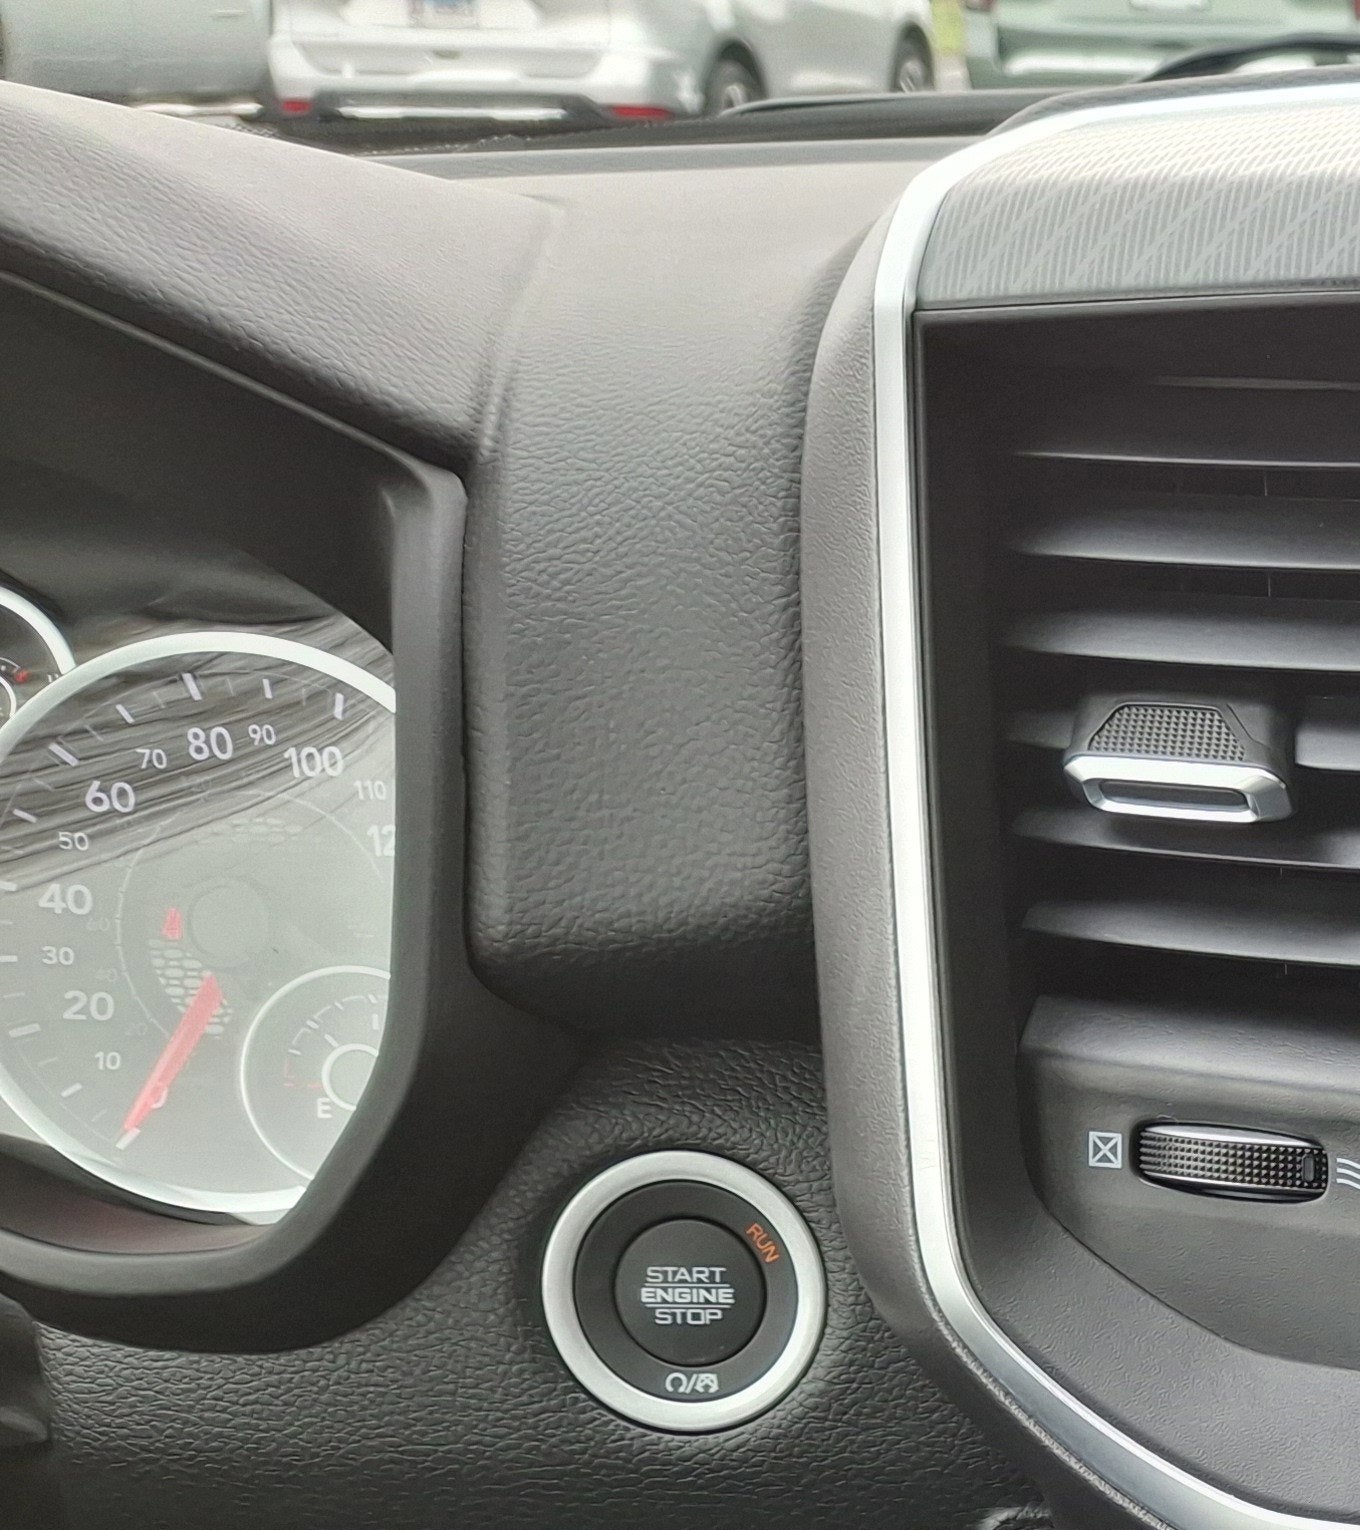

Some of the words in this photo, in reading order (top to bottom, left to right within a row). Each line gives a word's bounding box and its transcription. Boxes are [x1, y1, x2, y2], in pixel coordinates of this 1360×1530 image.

[187, 726, 233, 761] 80
[248, 724, 276, 745] 90
[136, 748, 167, 769] 70
[284, 746, 344, 777] 100
[85, 780, 135, 813] 60
[354, 780, 386, 800] 110
[58, 831, 89, 851] 50
[38, 884, 93, 915] 40
[42, 945, 75, 966] 30
[62, 989, 115, 1021] 20
[95, 1051, 121, 1070] 10
[317, 1098, 333, 1118] E
[746, 1223, 780, 1263] RUN
[646, 1267, 727, 1283] START
[640, 1288, 735, 1304] ENGINE
[654, 1309, 723, 1325] STOP
